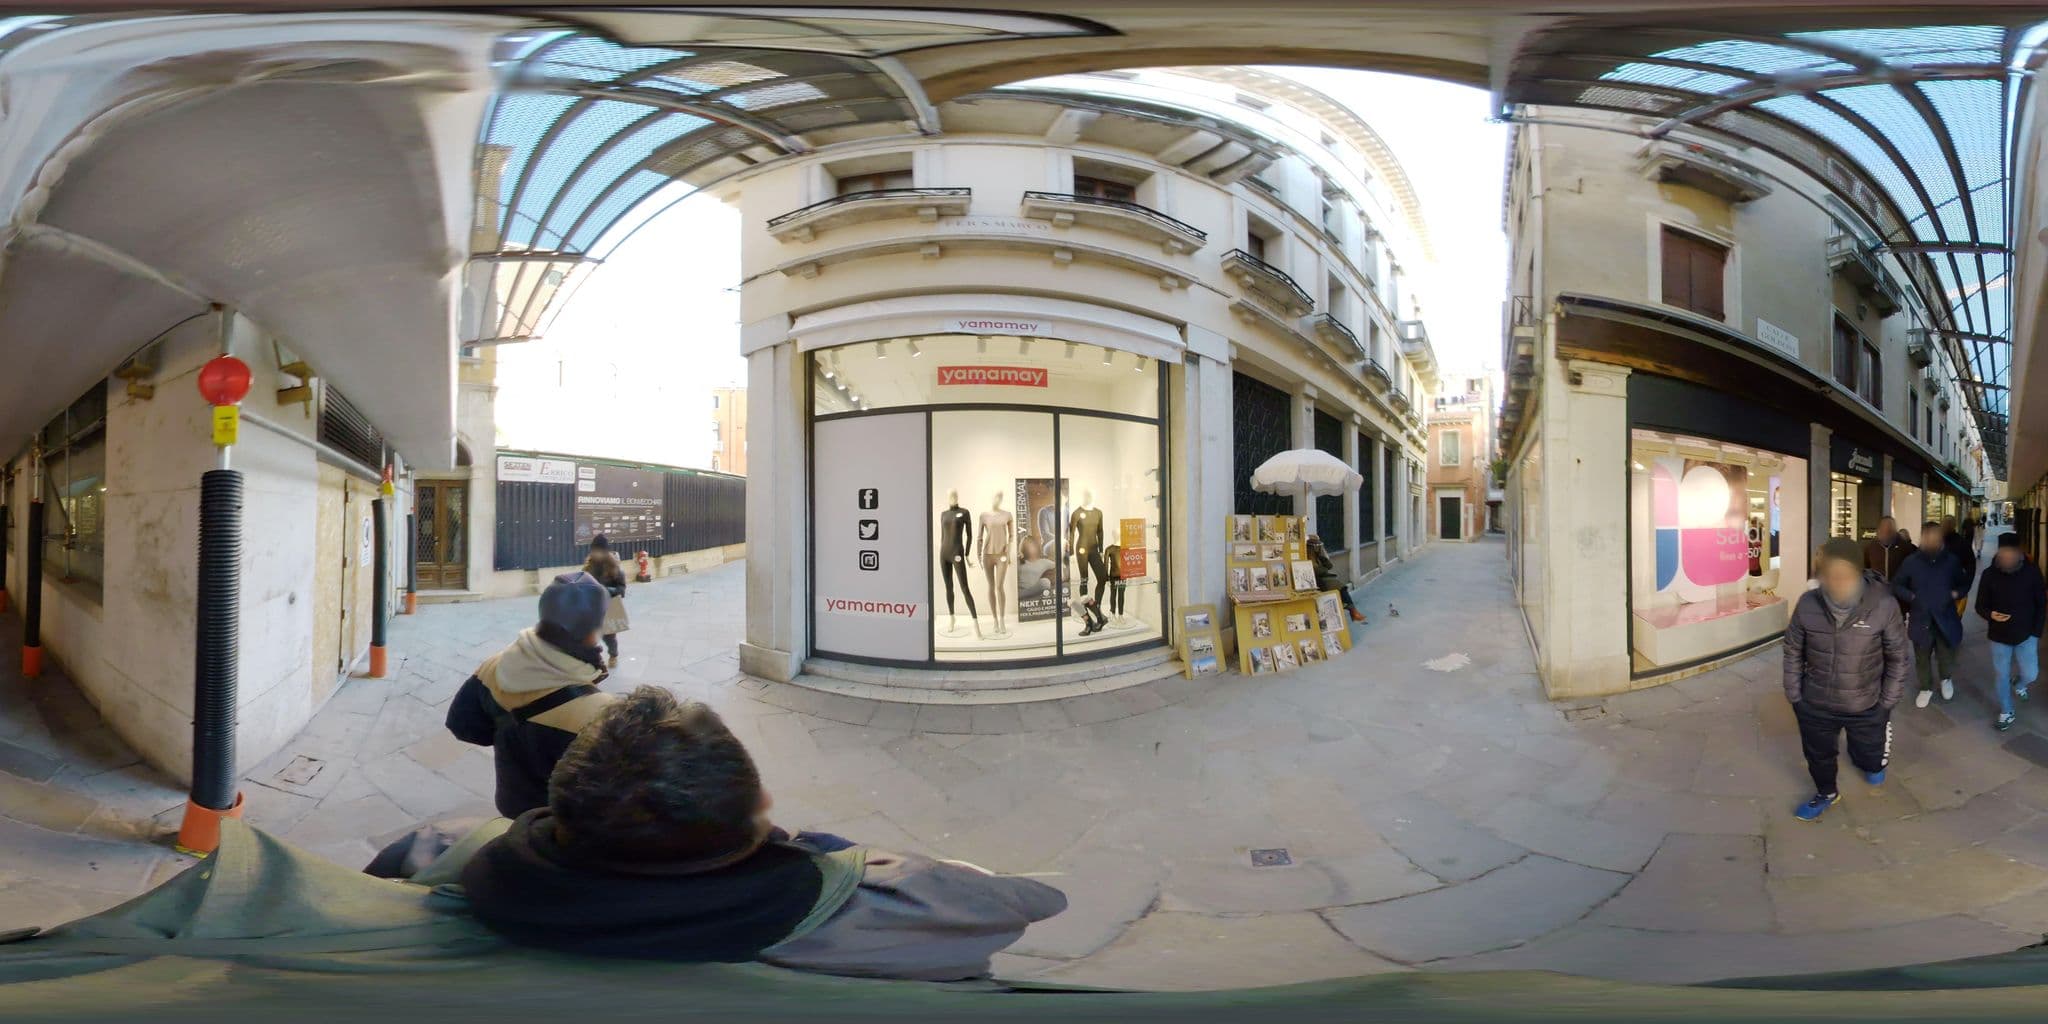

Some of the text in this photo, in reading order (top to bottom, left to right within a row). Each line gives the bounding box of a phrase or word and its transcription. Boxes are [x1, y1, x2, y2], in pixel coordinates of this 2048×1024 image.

[959, 320, 1038, 331] yamamay
[942, 369, 1043, 384] yamamay
[826, 598, 916, 618] yamamay
[1020, 600, 1039, 608] NEXT
